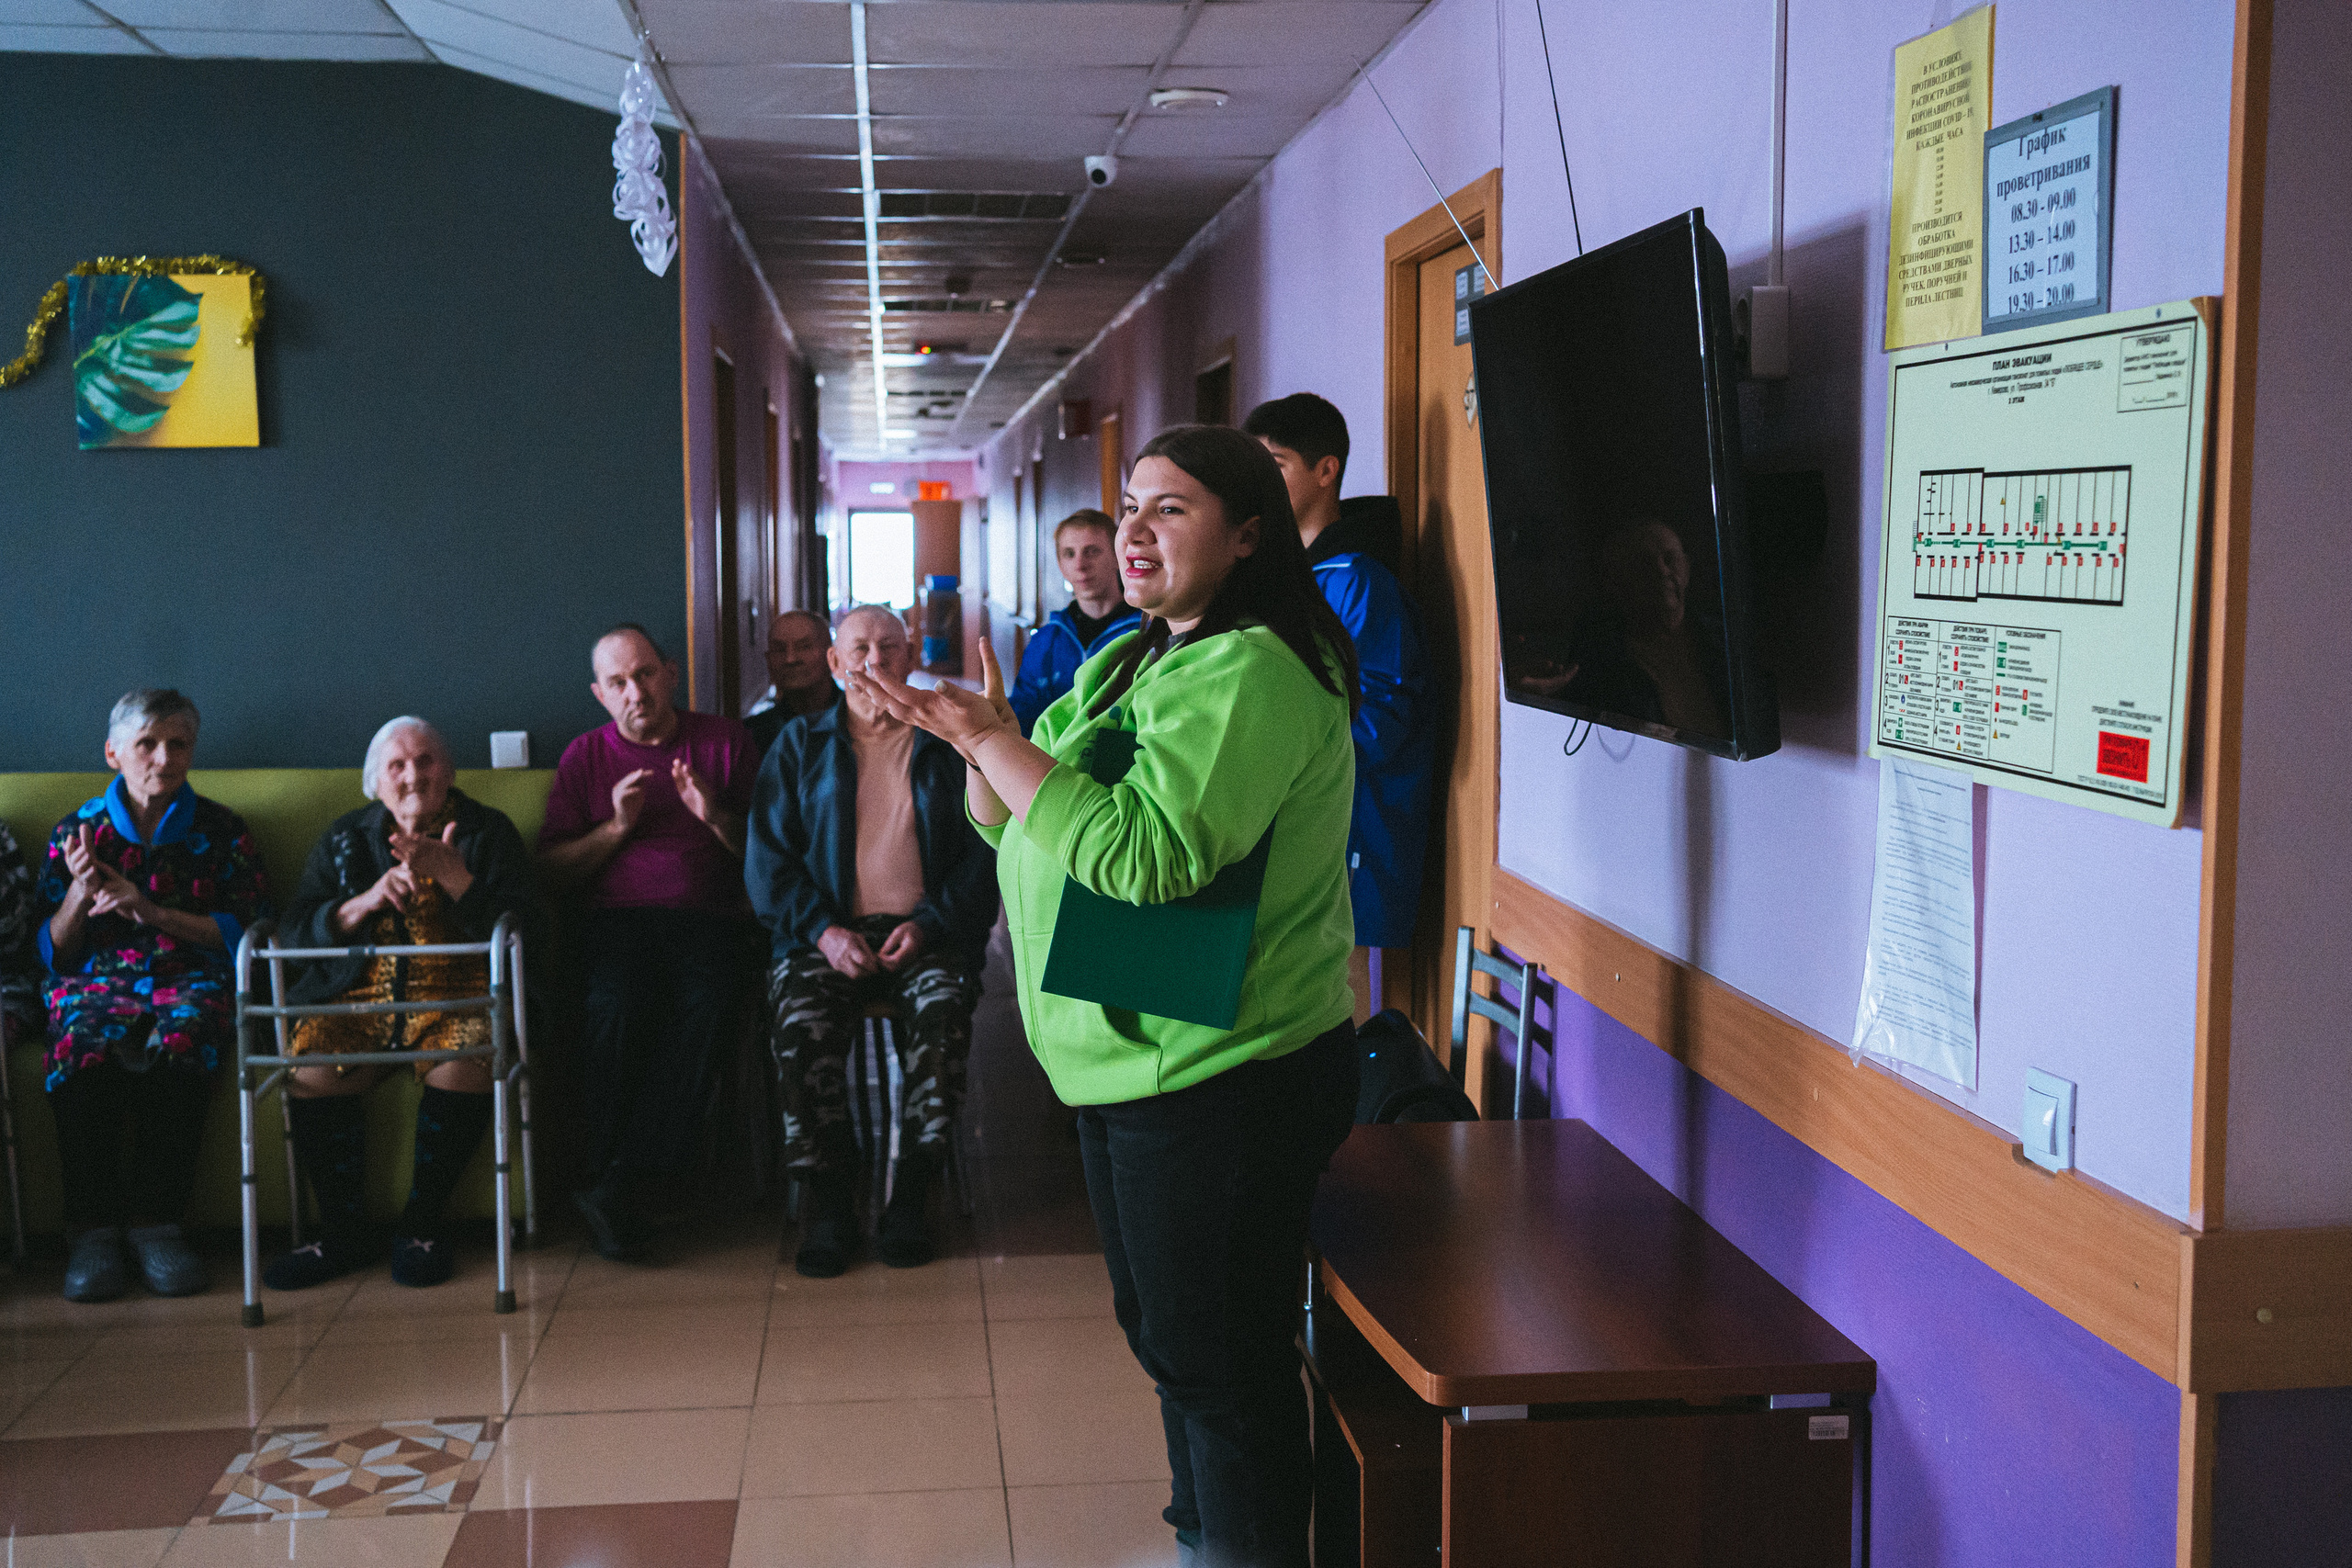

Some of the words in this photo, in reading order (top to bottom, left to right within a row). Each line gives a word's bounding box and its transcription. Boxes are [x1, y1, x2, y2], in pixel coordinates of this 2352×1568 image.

[1912, 61, 1972, 95] ПРОТИВОДЕЙСТ
[1912, 92, 1970, 123] КОРОНАВИРУСНОЙ
[1906, 118, 1941, 140] ИНФЕКЦИИ
[1943, 111, 1962, 127] COVID
[1916, 133, 1944, 151] КАЖДЫЕ
[1947, 127, 1963, 140] ЧАСА
[2019, 127, 2066, 160] График
[1996, 153, 2091, 201] проветривания
[2011, 198, 2038, 223] 08.30
[2047, 187, 2076, 213] 09.00
[1912, 211, 1962, 233] ПРОИЗВОДИТСЯ
[1917, 230, 1955, 246] ОБРАБОТКА
[2009, 230, 2035, 254] 13.30
[2047, 220, 2075, 244] 14.00
[1898, 261, 1942, 279] СРЕДСТВАМИ
[1943, 254, 1973, 270] ДВЕРНЫХ
[1899, 239, 1973, 265] ДЕЗИНФИЦИРУЮЩИМИ
[1927, 270, 1962, 288] ПОРУЧНЕЙ
[2009, 261, 2034, 284] 16.30
[2047, 251, 2075, 275] 17.00
[1905, 293, 1932, 307] ПЕРИЛА
[2008, 291, 2034, 313] 19.30
[2047, 283, 2075, 306] 20.00
[1993, 359, 2010, 370] ПЛАН
[2012, 353, 2052, 367] ЭВАКУАЦИИ
